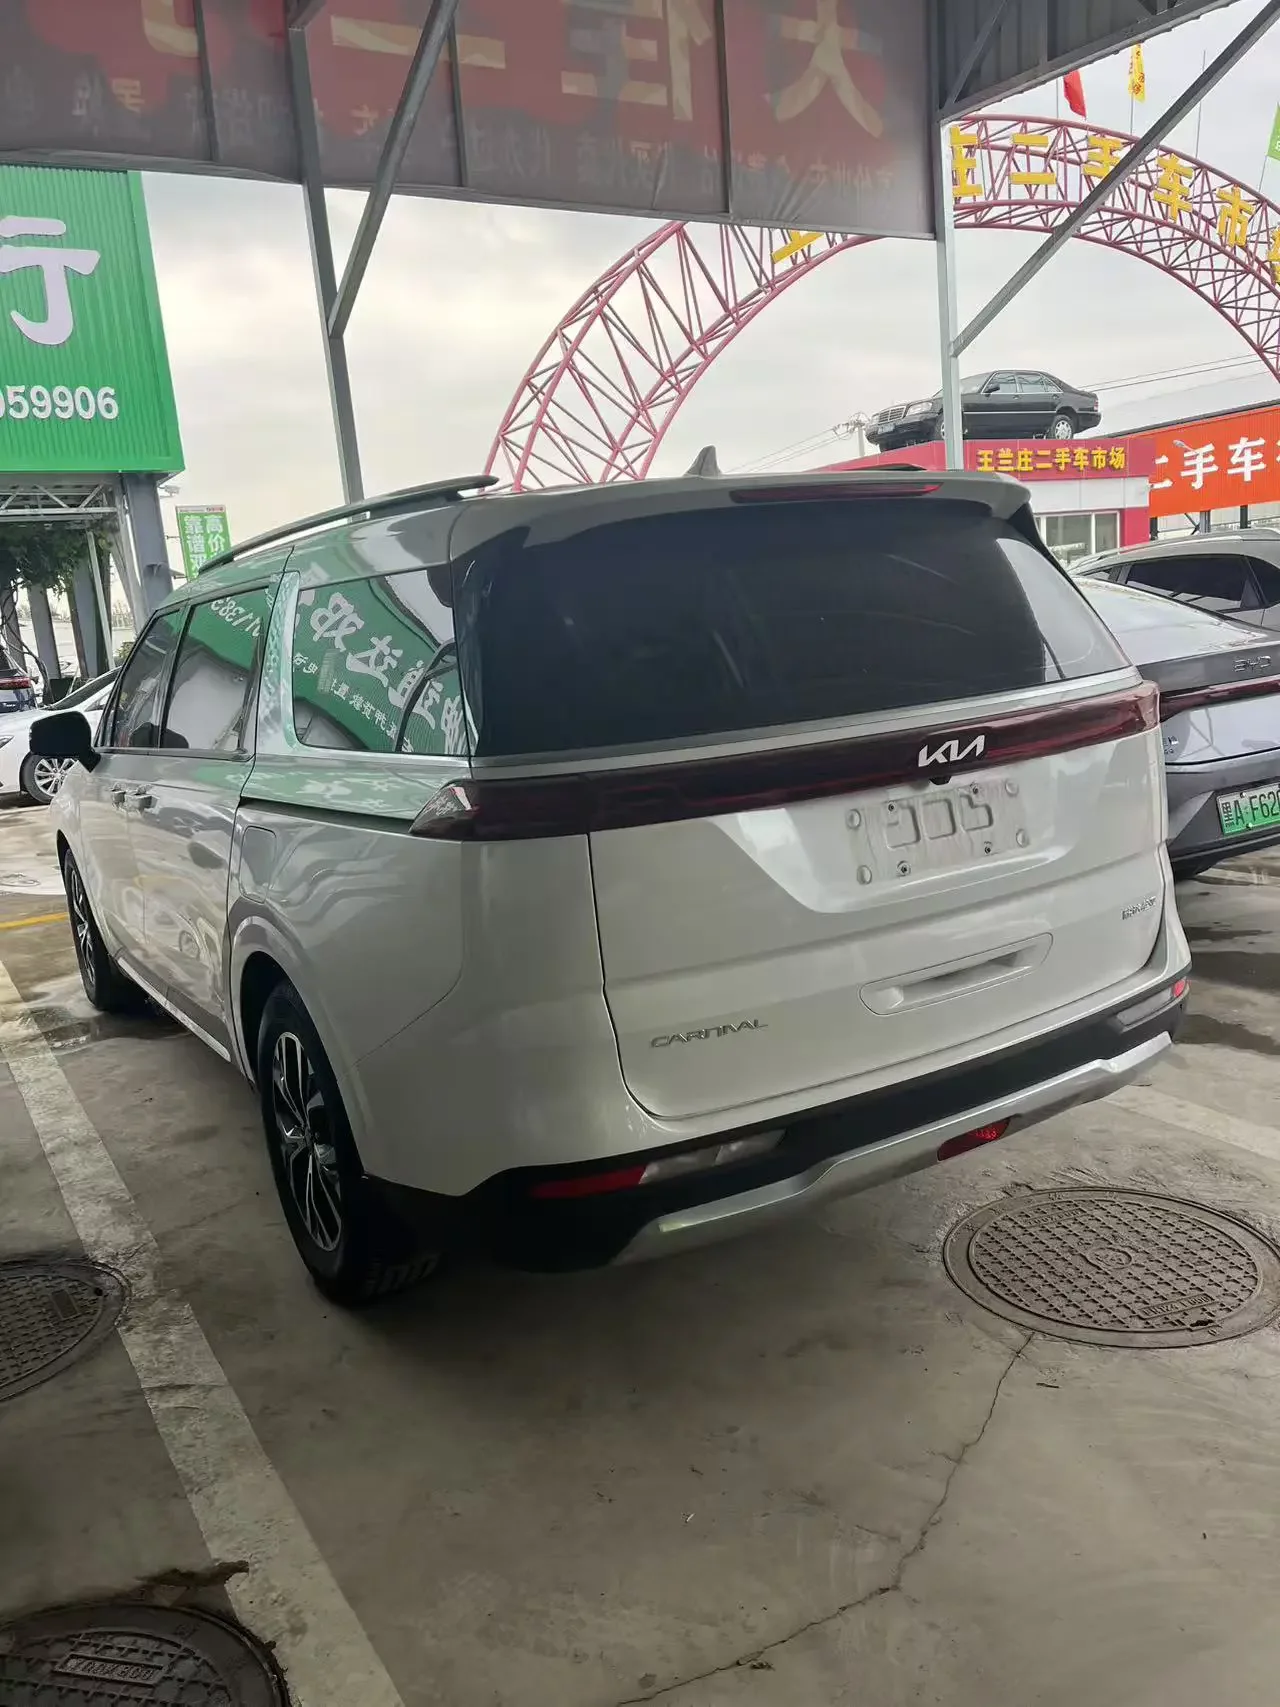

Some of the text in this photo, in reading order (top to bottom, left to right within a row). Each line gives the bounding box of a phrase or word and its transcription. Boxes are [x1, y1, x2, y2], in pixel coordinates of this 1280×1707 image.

[0, 384, 119, 420] 59906
[976, 446, 1126, 473] 王兰庄二手车市场
[917, 733, 986, 768] KIA
[650, 1018, 768, 1049] CARNIVAL
